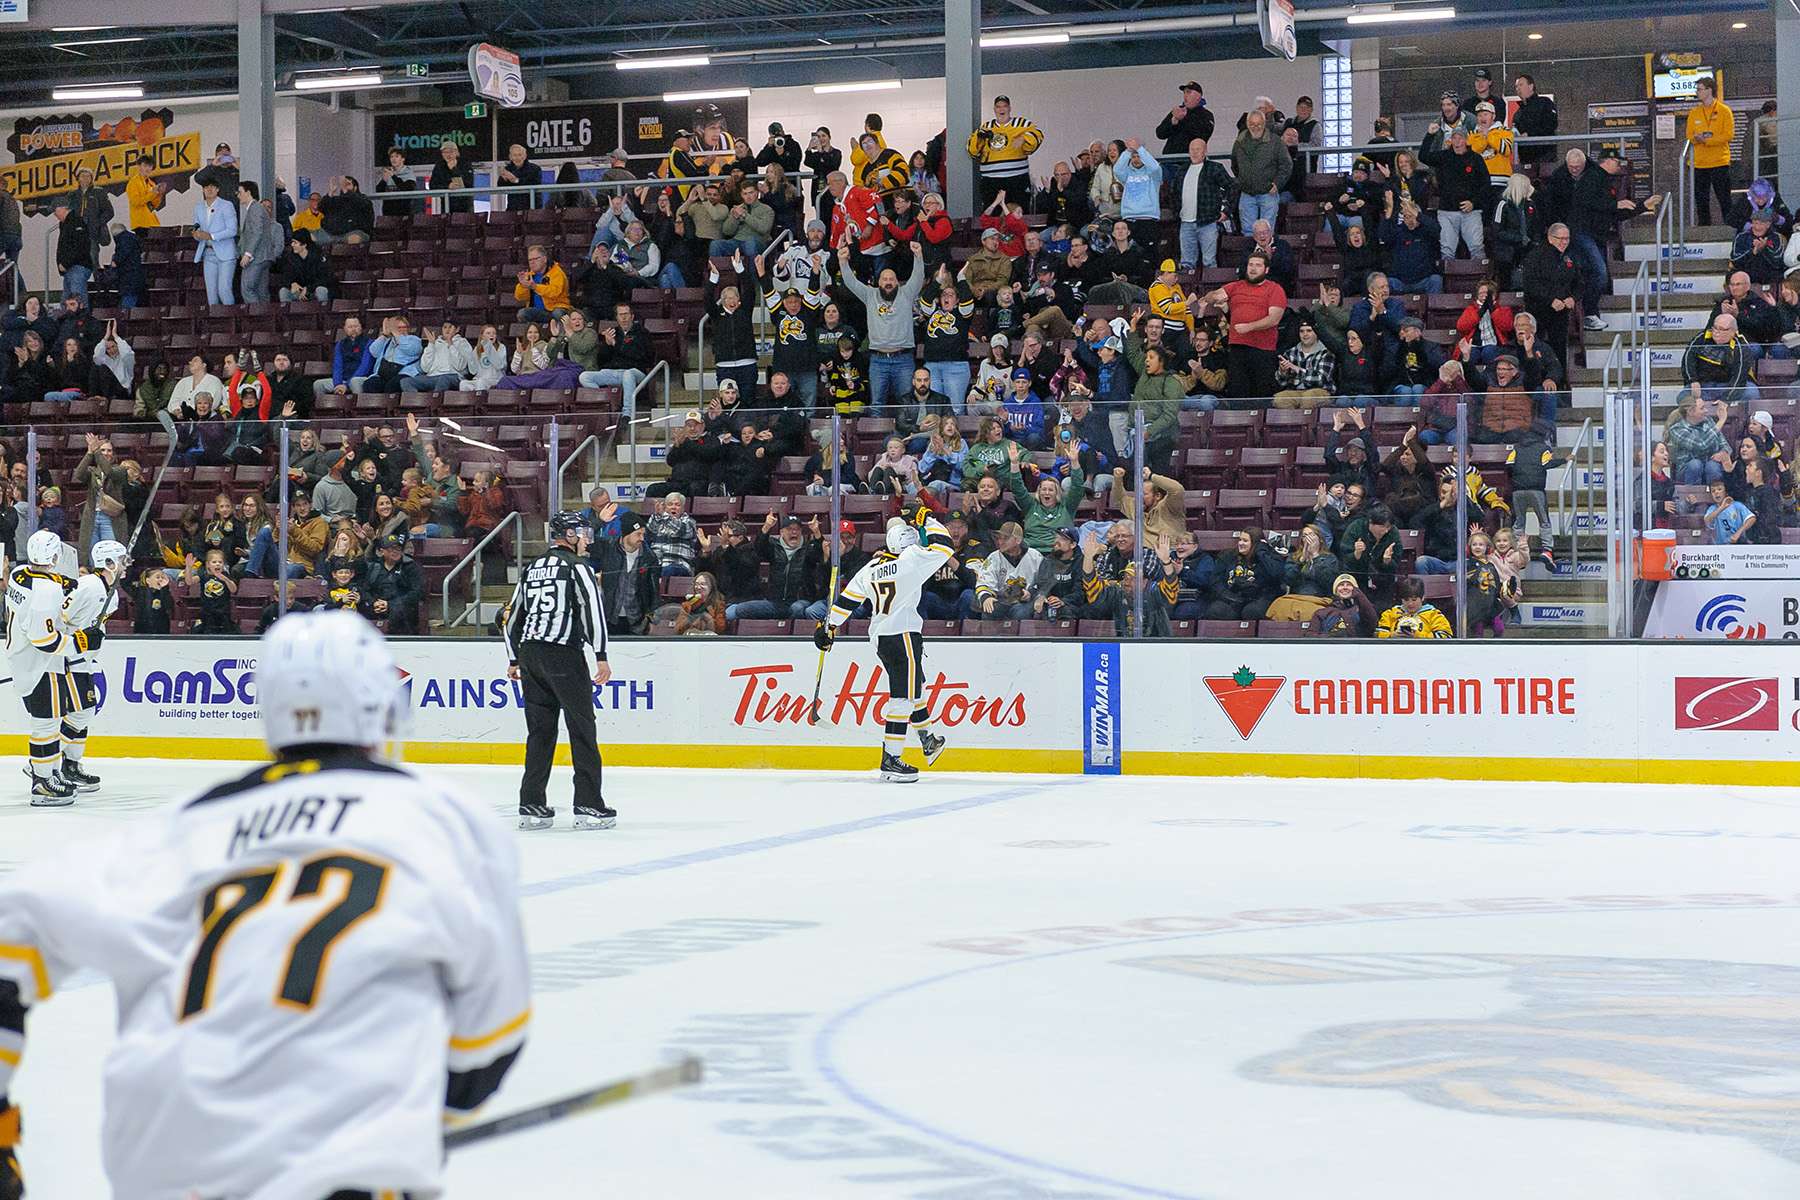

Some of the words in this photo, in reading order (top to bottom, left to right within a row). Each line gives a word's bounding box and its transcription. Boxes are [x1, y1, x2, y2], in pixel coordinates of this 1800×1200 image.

[20, 132, 84, 150] POWER
[526, 119, 573, 148] GATE
[578, 118, 592, 146] 6
[1561, 563, 1602, 573] WIMAR
[1681, 553, 1720, 562] Burckhardt
[1731, 553, 1745, 561] Proud
[1746, 553, 1764, 561] Partner
[1771, 553, 1784, 562] Sting
[1785, 553, 1800, 561] Hocke
[1761, 561, 1788, 569] Community
[527, 585, 555, 614] 75
[870, 581, 896, 615] 17
[1541, 607, 1584, 618] WINMAR
[45, 618, 54, 634] 8
[123, 657, 259, 705] LamSa
[729, 664, 823, 727] Tim
[830, 661, 1027, 728] Hotons
[1095, 653, 1109, 747] WINMAR.ca
[1294, 678, 1482, 715] CANADIAN
[1493, 677, 1575, 715] TIRE
[159, 709, 197, 720] building
[200, 709, 228, 719] better
[227, 796, 361, 860] HURT
[177, 848, 395, 1024] 77
[930, 892, 1782, 956] PROGRESS
